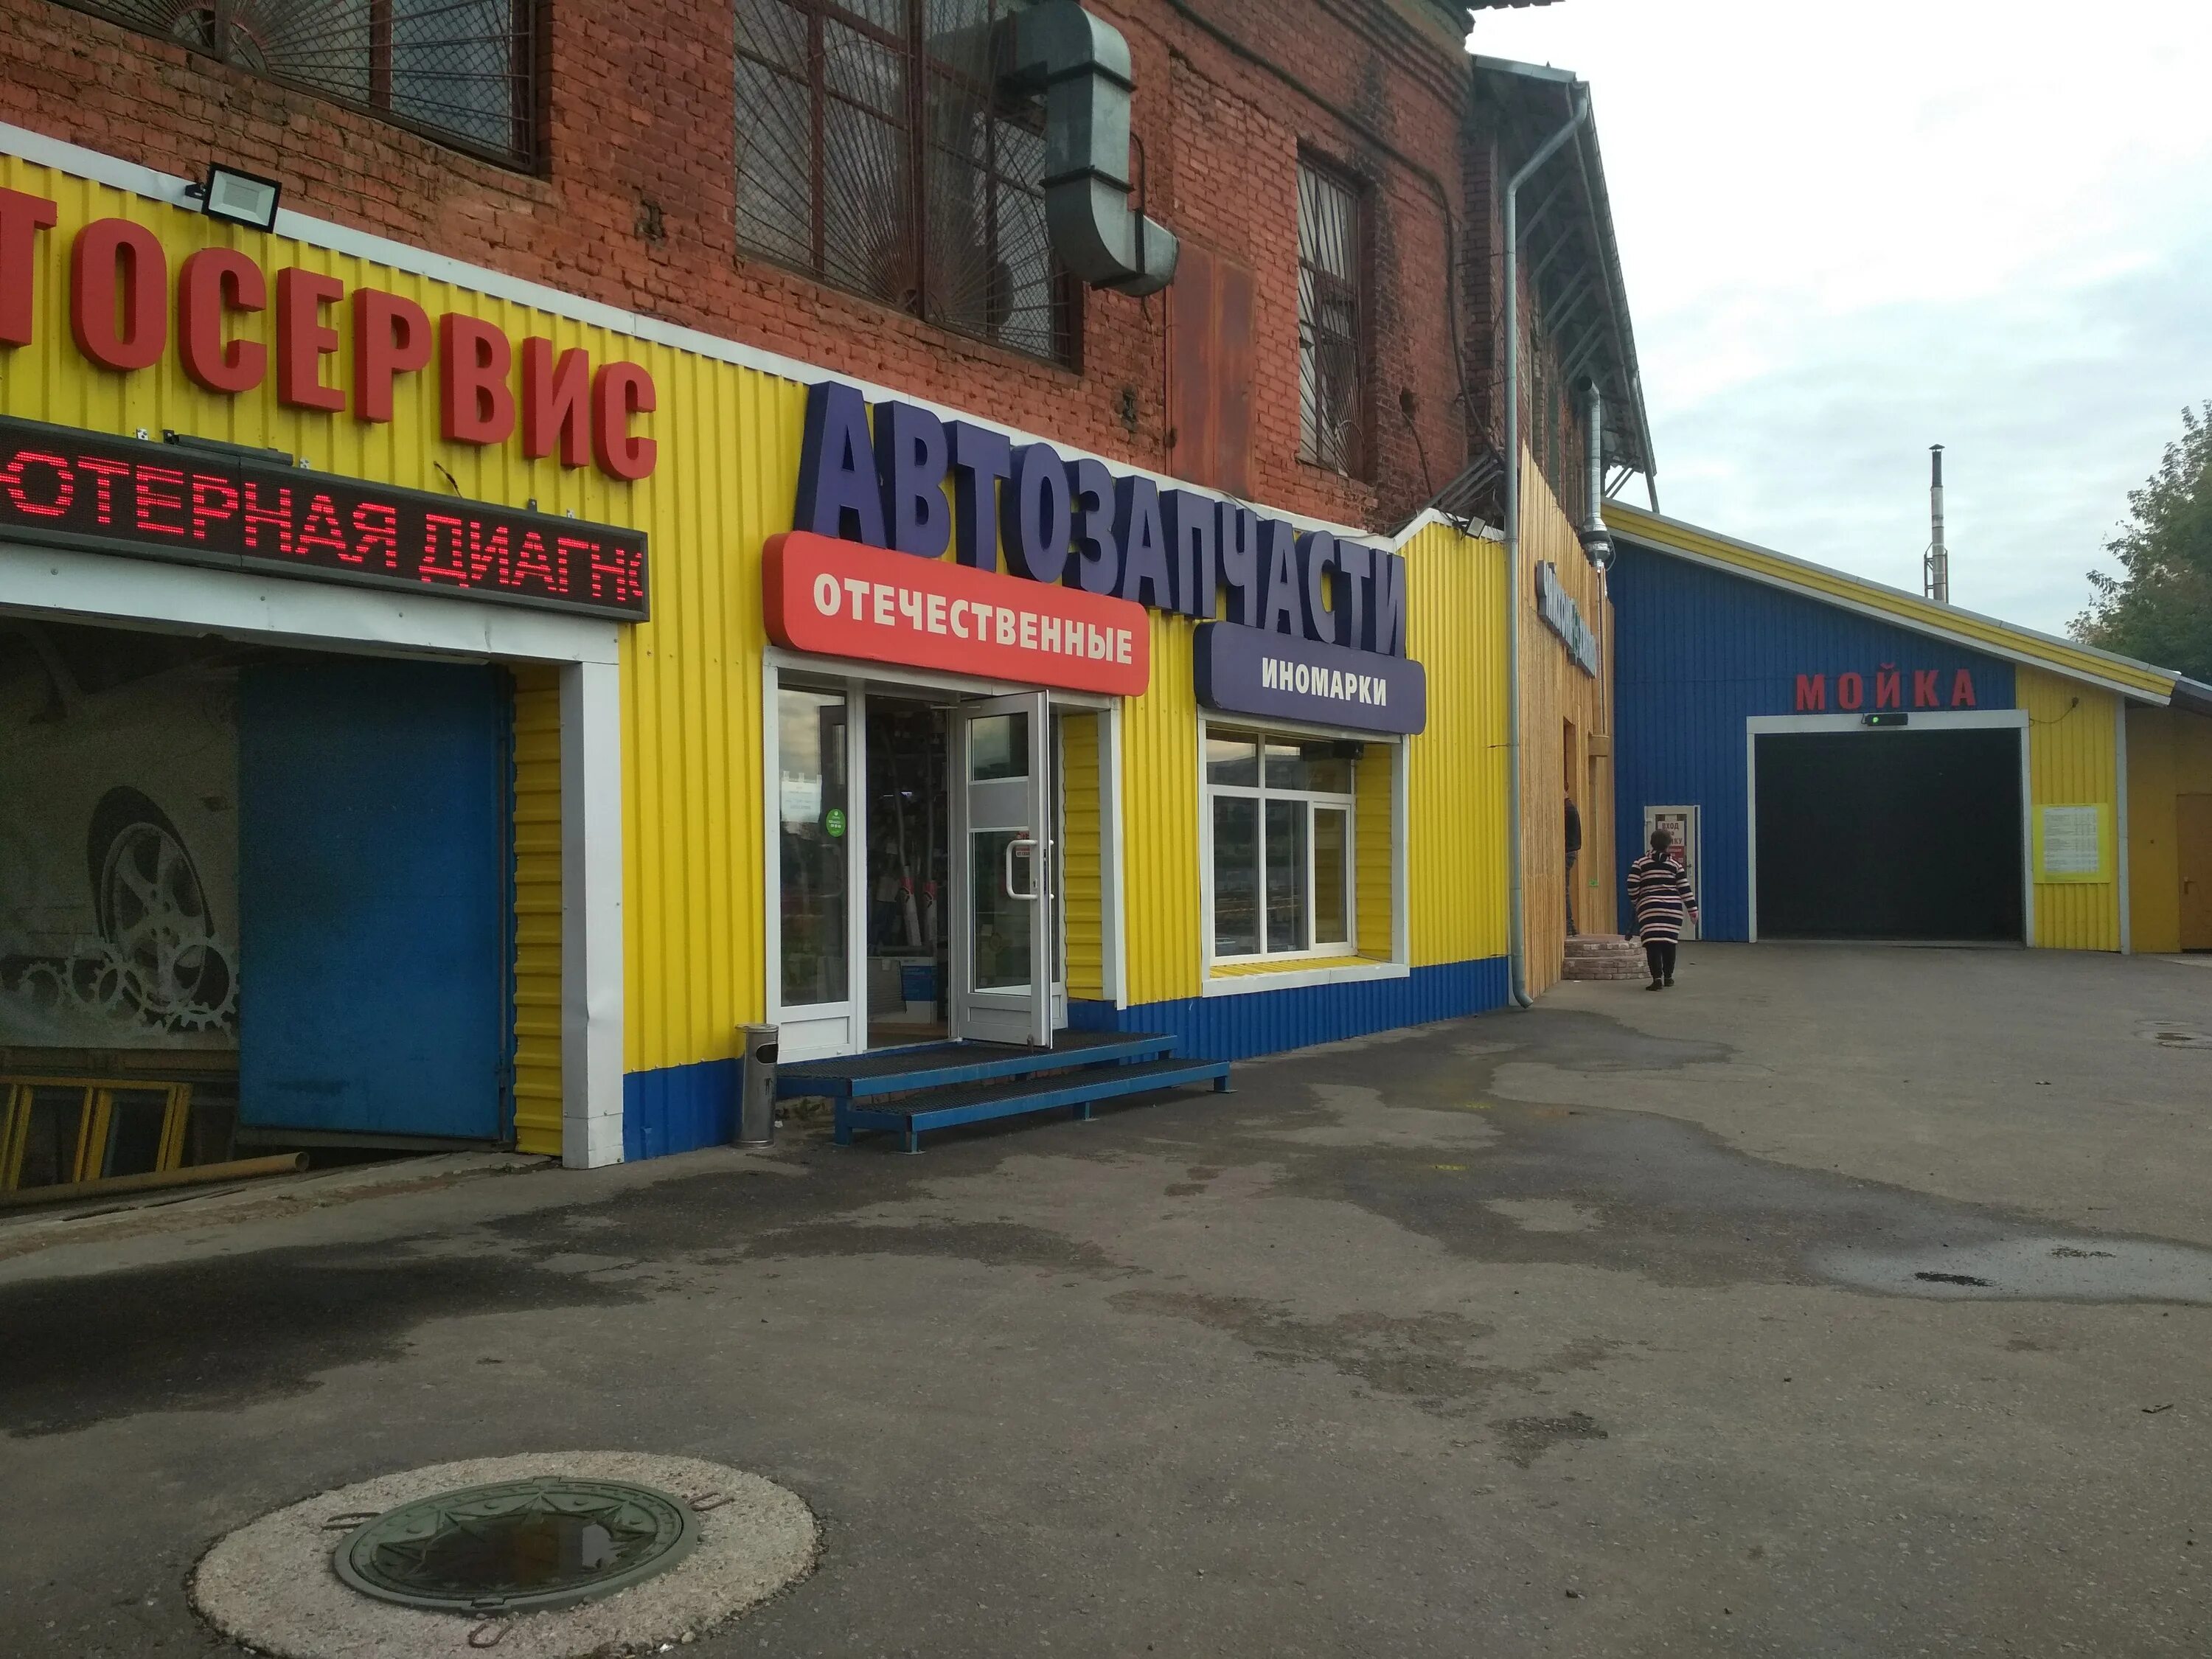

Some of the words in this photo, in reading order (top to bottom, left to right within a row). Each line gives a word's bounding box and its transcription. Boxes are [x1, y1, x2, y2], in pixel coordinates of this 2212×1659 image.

[0, 187, 657, 481] ТОСЕРВИС
[0, 450, 397, 568] ЮТЕРНАЯ
[794, 380, 1406, 658] АВТОЗАПЧАСТИ
[813, 573, 1133, 665] ОТЕЧЕСТВЕННЫЕ
[1261, 657, 1387, 707] ИНОМАРКИ
[1795, 662, 1976, 710] МОЙКА
[1663, 822, 1679, 830] ВХОД
